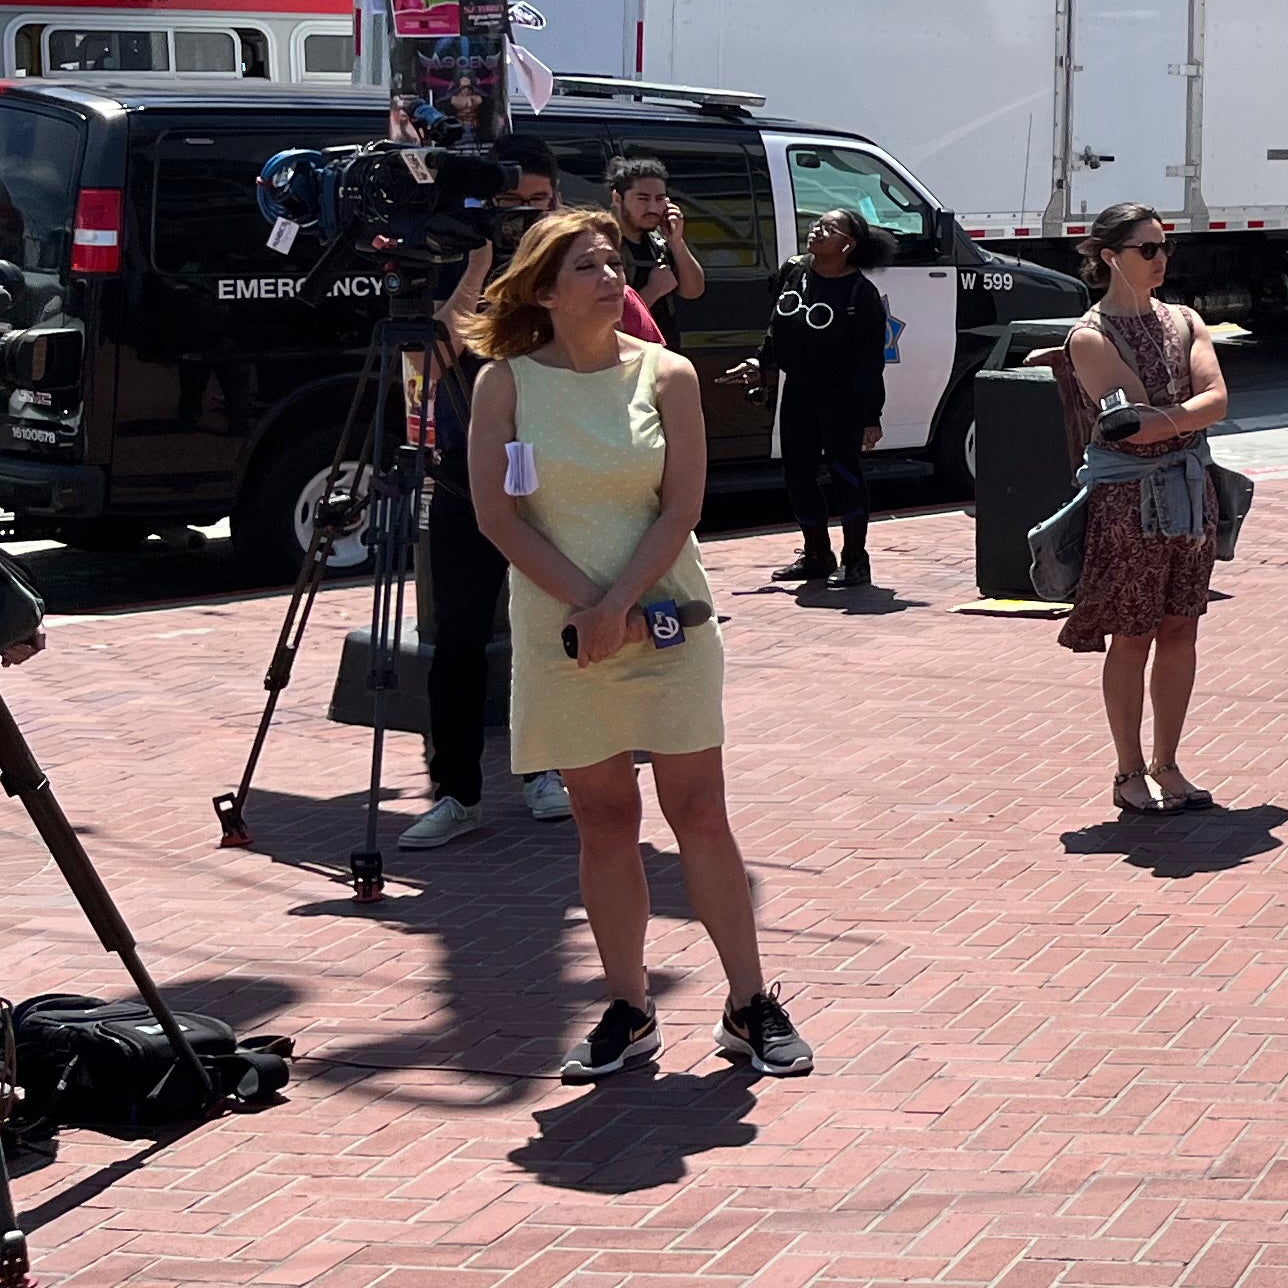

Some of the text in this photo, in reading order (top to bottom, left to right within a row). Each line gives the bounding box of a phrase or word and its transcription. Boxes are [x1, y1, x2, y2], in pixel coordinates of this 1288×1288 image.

[218, 277, 383, 299] EMERNCY
[961, 272, 1013, 291] W 599
